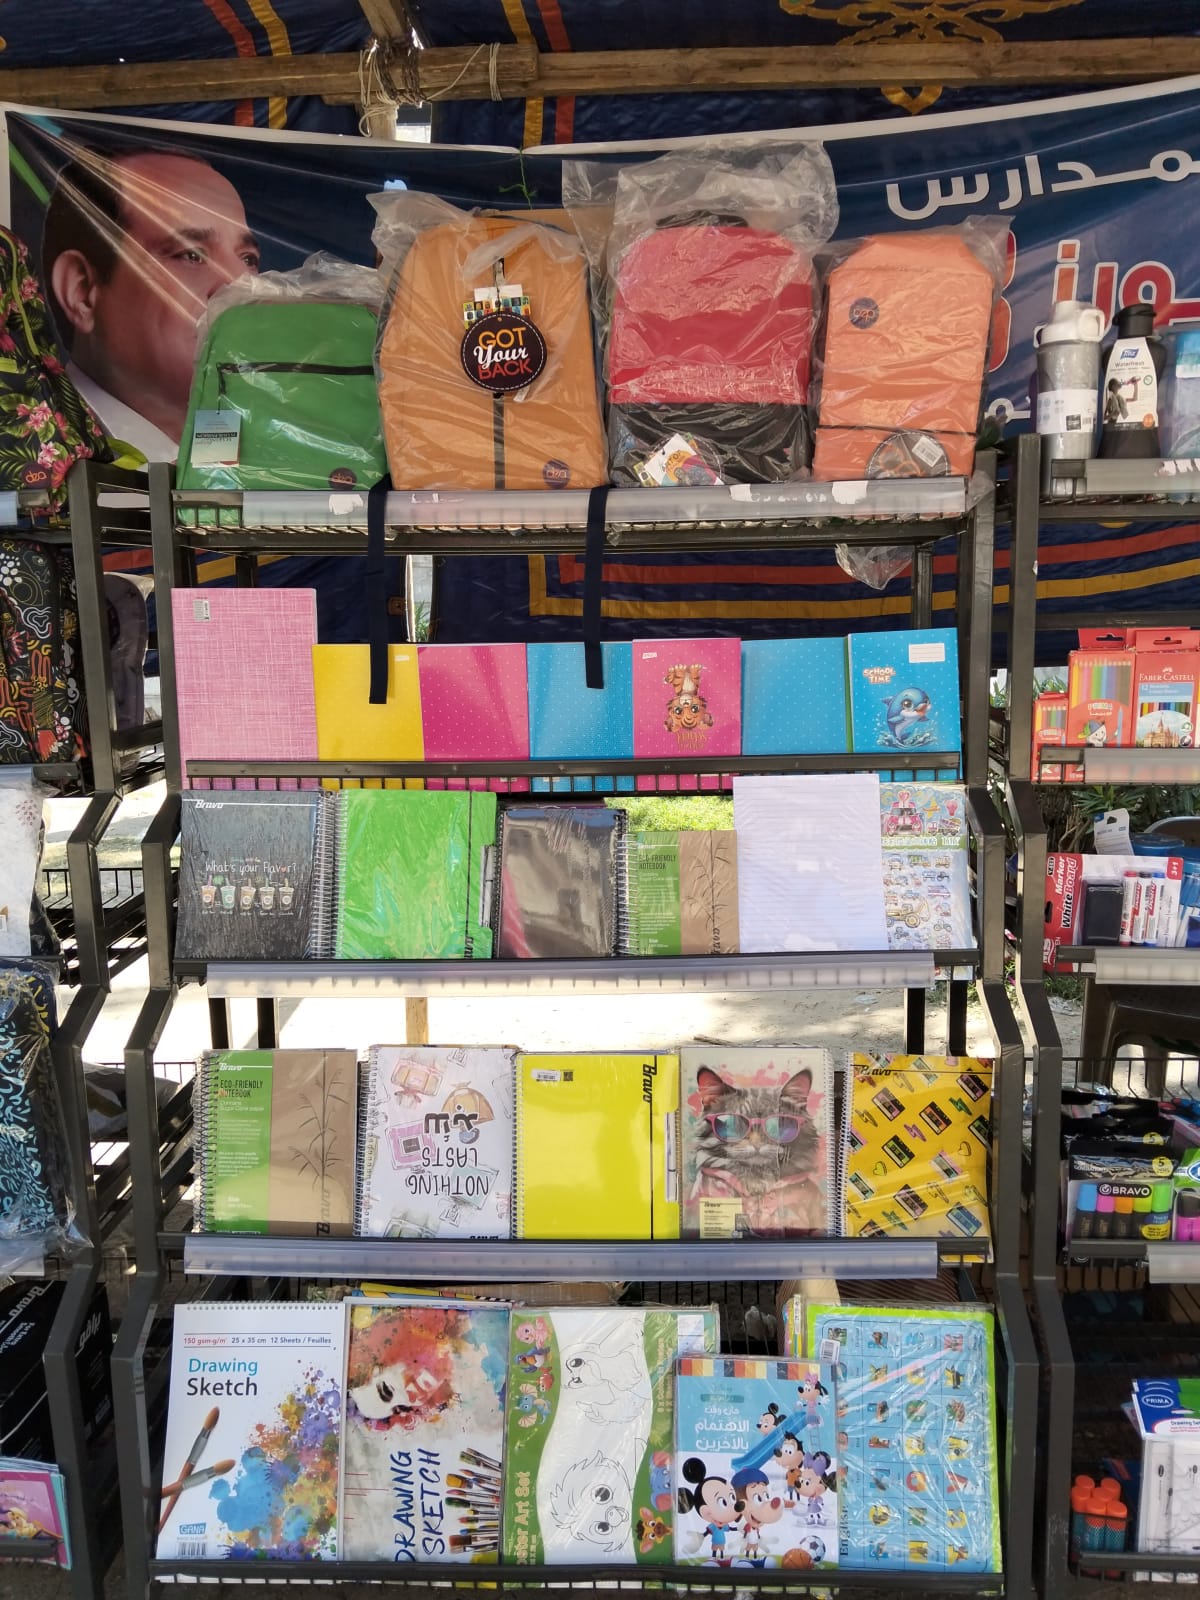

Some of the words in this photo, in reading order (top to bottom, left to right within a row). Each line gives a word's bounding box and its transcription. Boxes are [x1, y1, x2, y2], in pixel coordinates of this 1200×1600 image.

[478, 327, 527, 350] GOT
[473, 344, 529, 370] Your
[477, 357, 533, 379] BACK
[863, 666, 896, 677] SCHOOL
[869, 675, 891, 684] TIME
[195, 799, 224, 809] Bravo
[205, 861, 236, 872] What's
[239, 863, 259, 875] your
[1055, 856, 1066, 895] Marker
[220, 1079, 264, 1089] ECO-FRIENDLY
[220, 1089, 251, 1098] NOTEBOOK
[642, 1064, 658, 1104] Bravo
[424, 1105, 479, 1143] للأبد
[421, 1147, 478, 1168] LASTS
[1158, 1157, 1165, 1168] 5
[407, 1174, 489, 1197] NOTHING
[1112, 1187, 1150, 1197] BRAVO
[8, 1286, 45, 1317] Bravo
[279, 1336, 301, 1344] Sheets
[307, 1336, 332, 1344] Feuilles
[188, 1358, 258, 1376] Drawing
[187, 1377, 258, 1396] Sketch
[514, 1471, 531, 1498] Set
[417, 1448, 445, 1556] SKETCH
[514, 1501, 530, 1526] Art
[515, 1528, 529, 1565] oster
